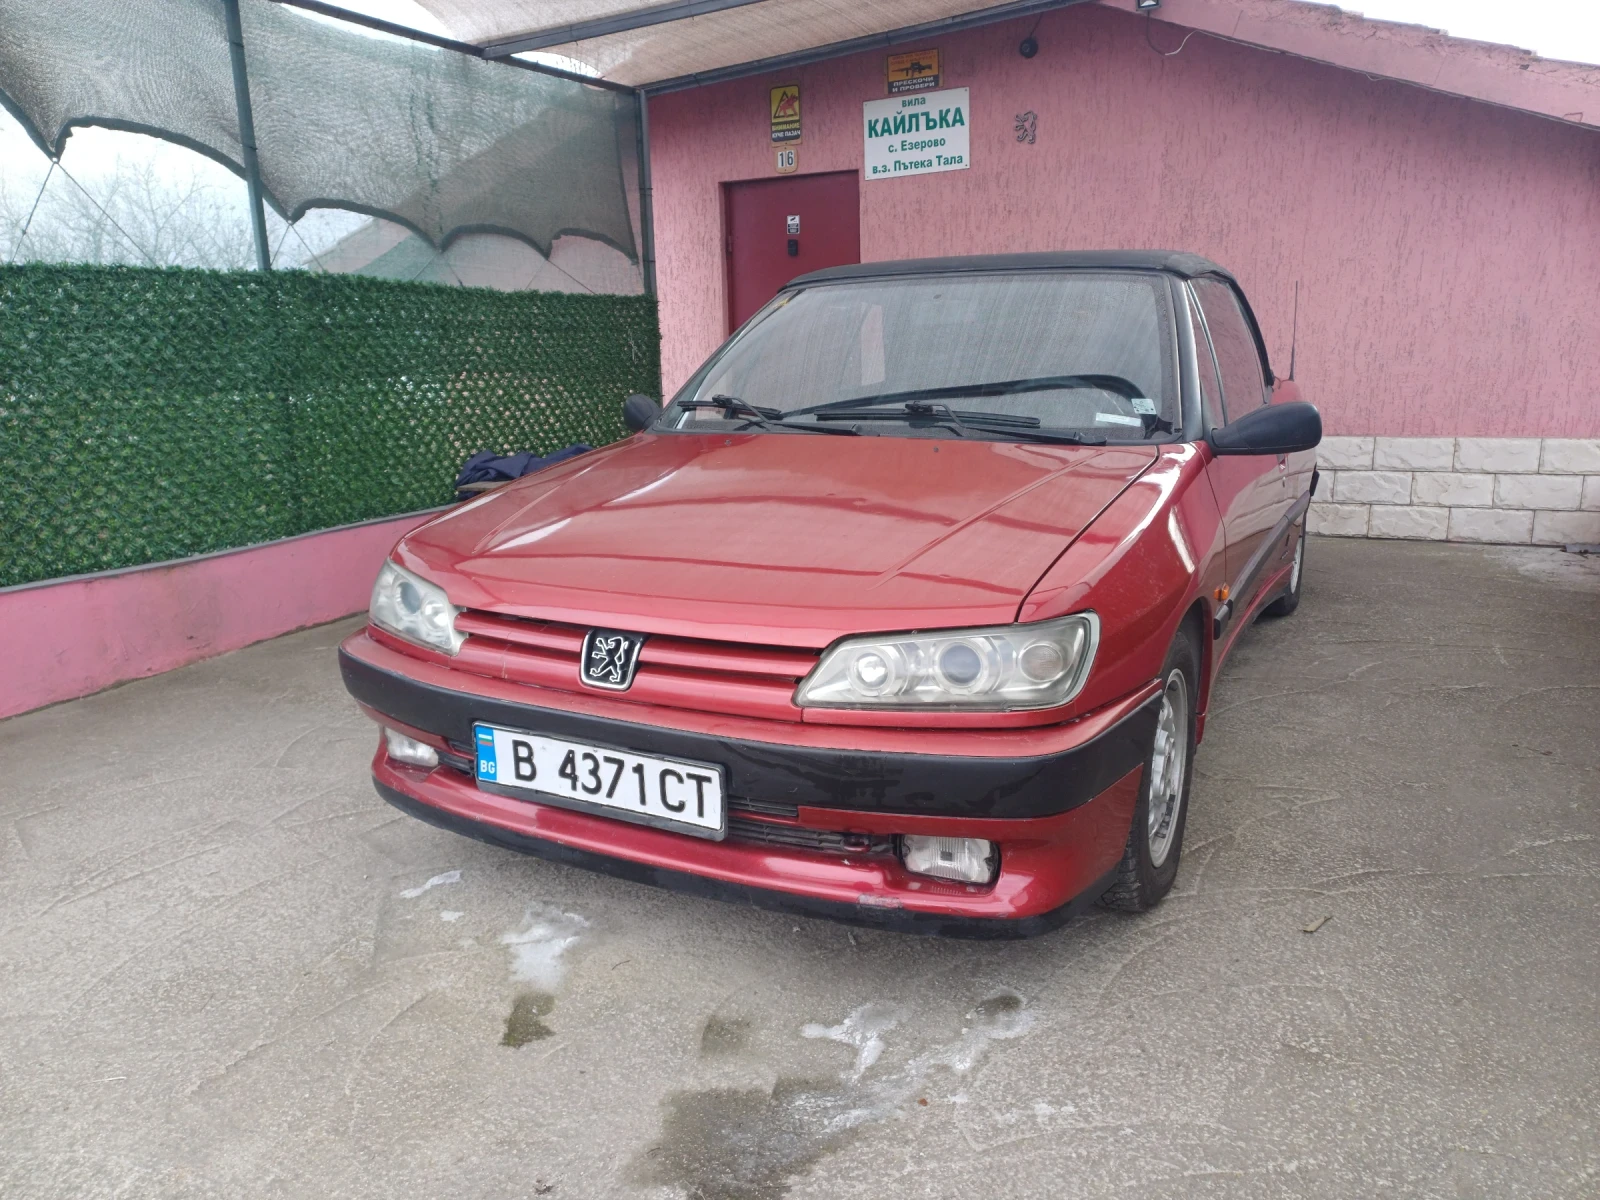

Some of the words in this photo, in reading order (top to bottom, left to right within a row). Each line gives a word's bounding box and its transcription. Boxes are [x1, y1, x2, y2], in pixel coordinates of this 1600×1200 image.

[893, 76, 934, 87] ПРЕСКОЧИ
[900, 81, 935, 91] ПРОВЕРИ
[902, 97, 926, 108] вила
[868, 107, 965, 138] КАЙЛЪКА
[888, 144, 898, 153] с.
[901, 138, 946, 151] Езерово
[779, 151, 794, 167] 16
[872, 164, 890, 174] в.з.
[894, 159, 933, 171] Пътека
[936, 155, 963, 166] Тала
[480, 759, 495, 774] BG
